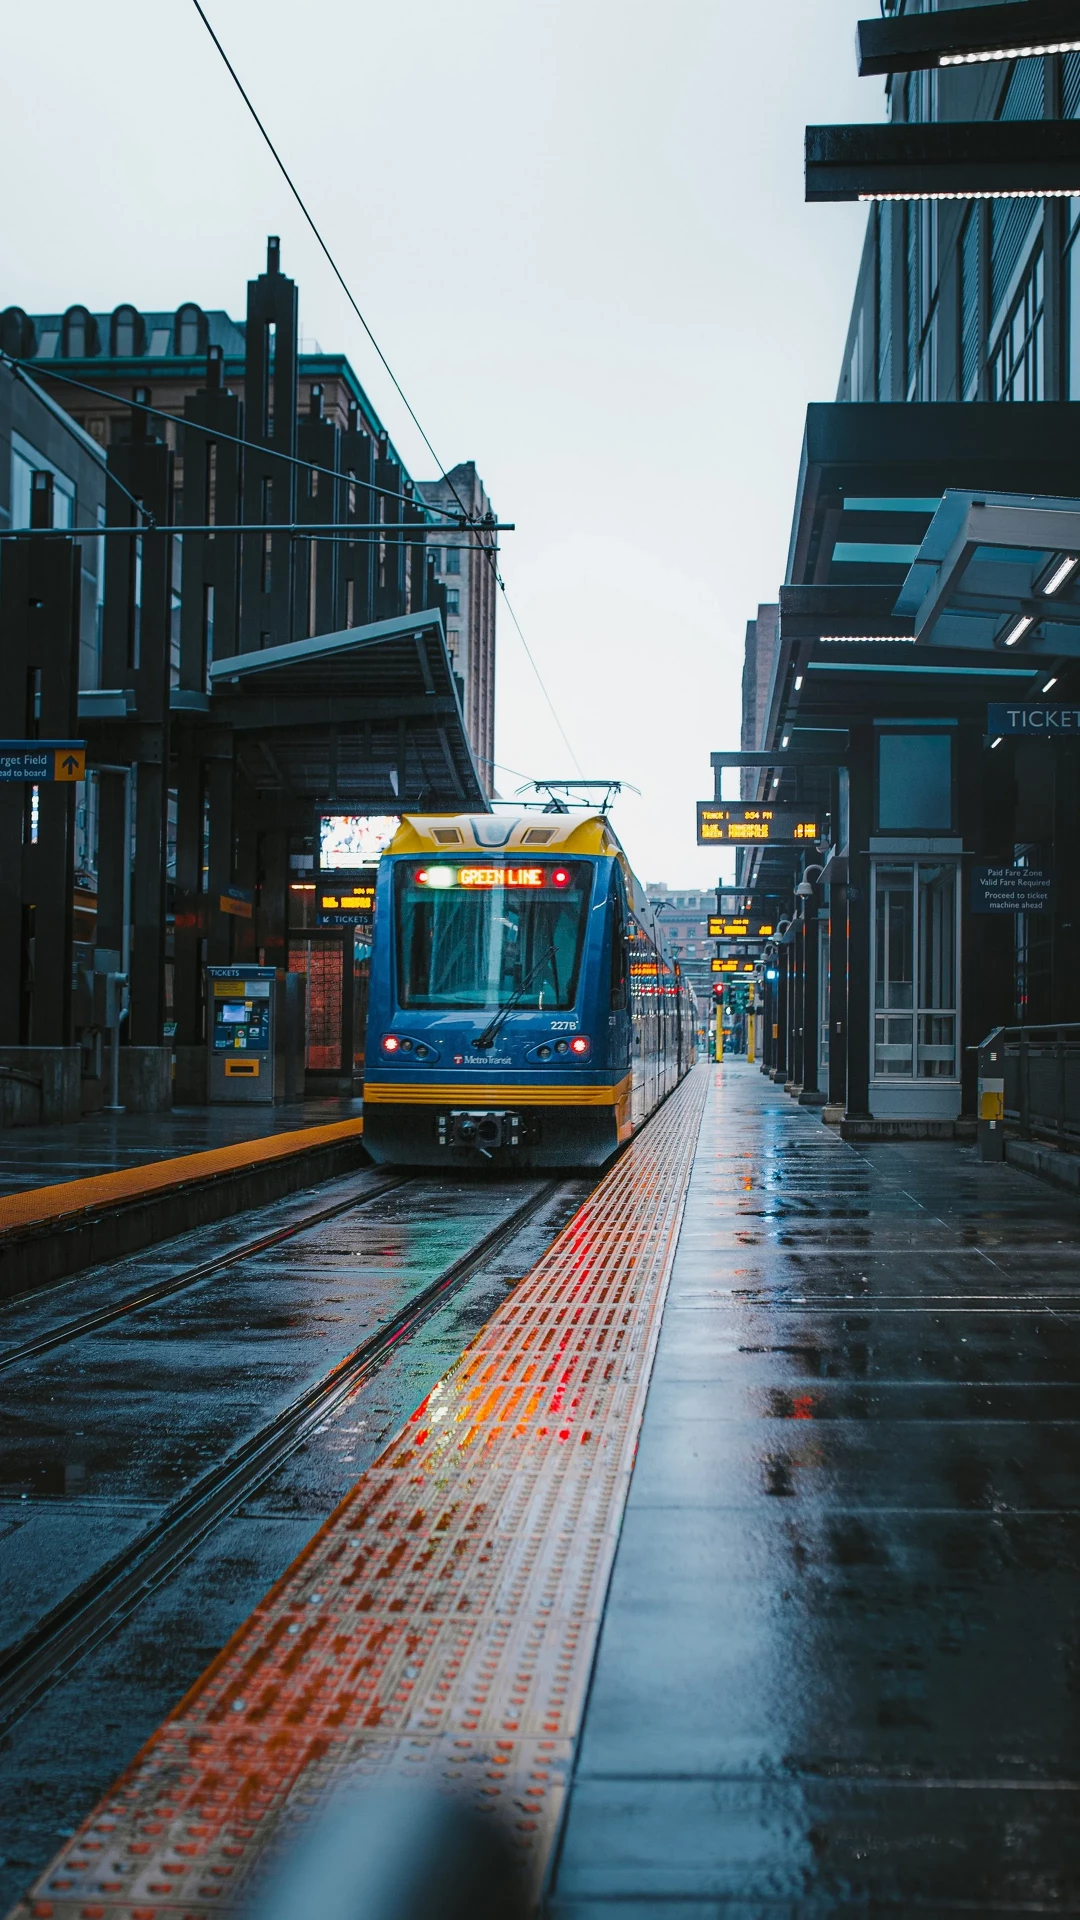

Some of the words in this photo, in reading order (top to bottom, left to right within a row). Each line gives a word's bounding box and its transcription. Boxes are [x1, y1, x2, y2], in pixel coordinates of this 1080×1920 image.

[0, 757, 20, 767] rget
[24, 755, 47, 764] Field
[762, 812, 772, 820] PM
[461, 870, 504, 884] GREEN
[508, 870, 542, 884] LINE
[550, 1021, 577, 1030] 227B
